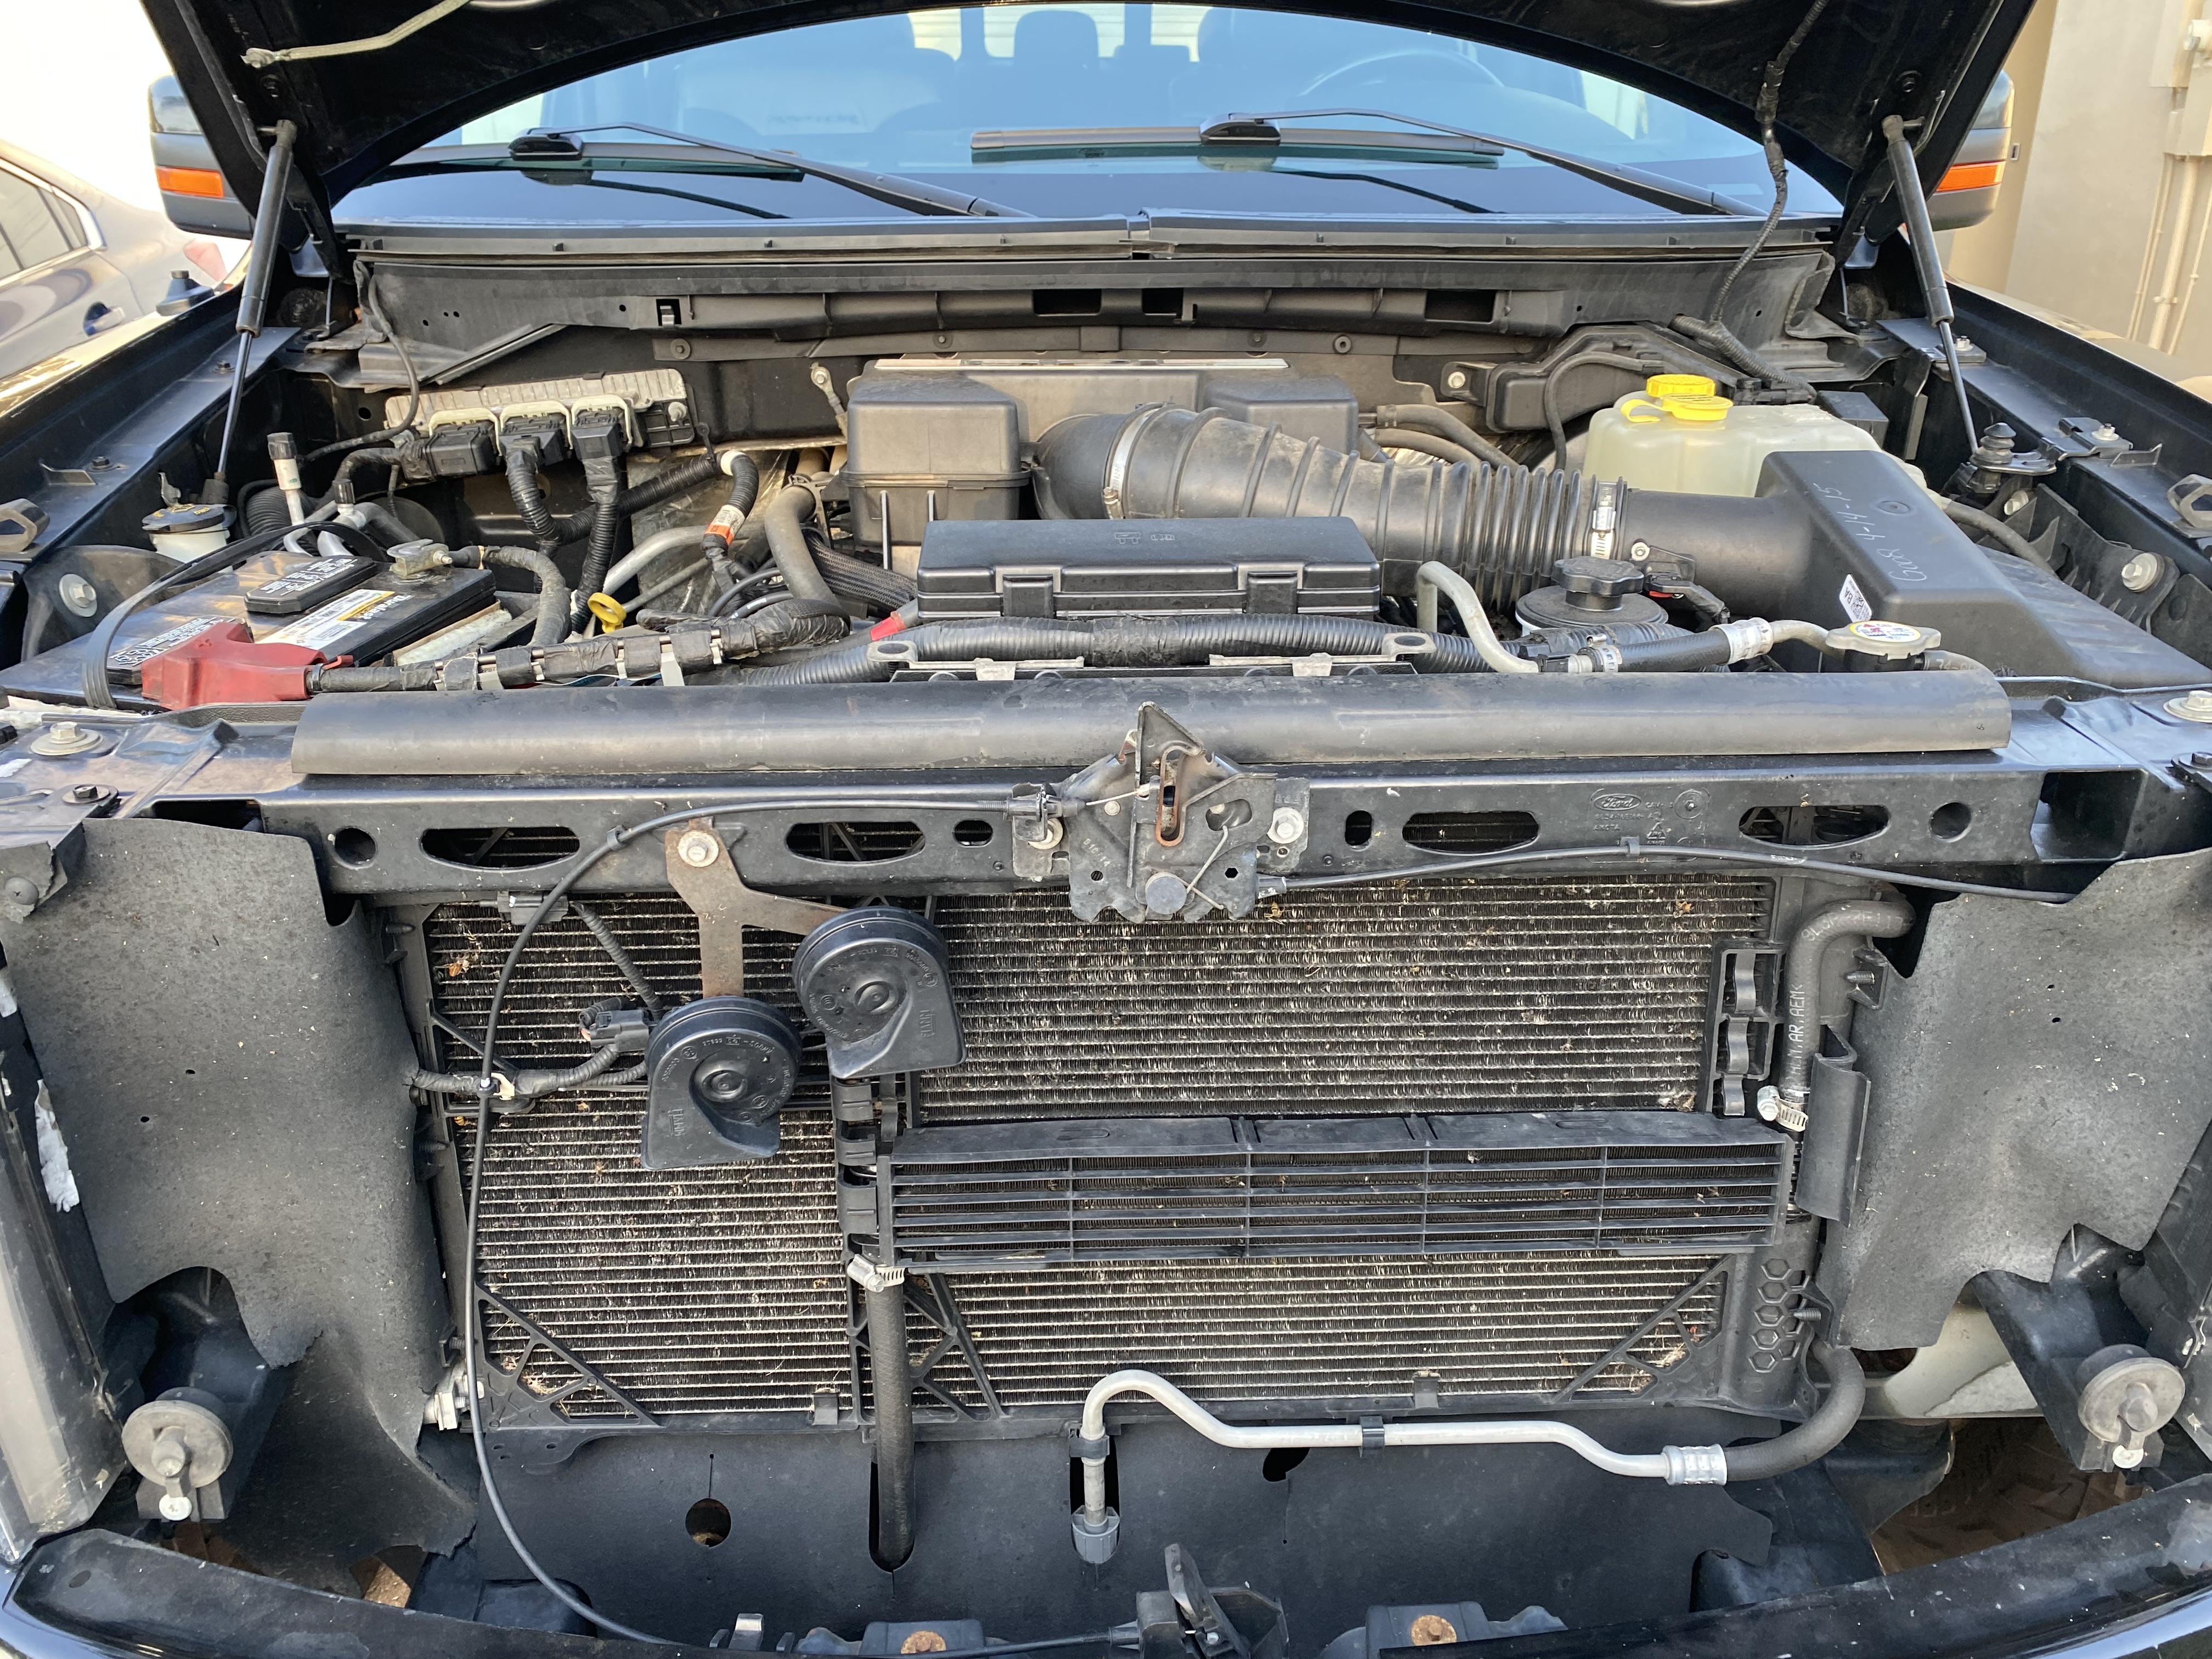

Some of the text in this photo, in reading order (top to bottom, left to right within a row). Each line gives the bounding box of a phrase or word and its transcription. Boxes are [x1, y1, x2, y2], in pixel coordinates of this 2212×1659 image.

[1844, 586, 1853, 605] BA
[358, 594, 412, 620] Duralast
[1601, 795, 1635, 809] Ford
